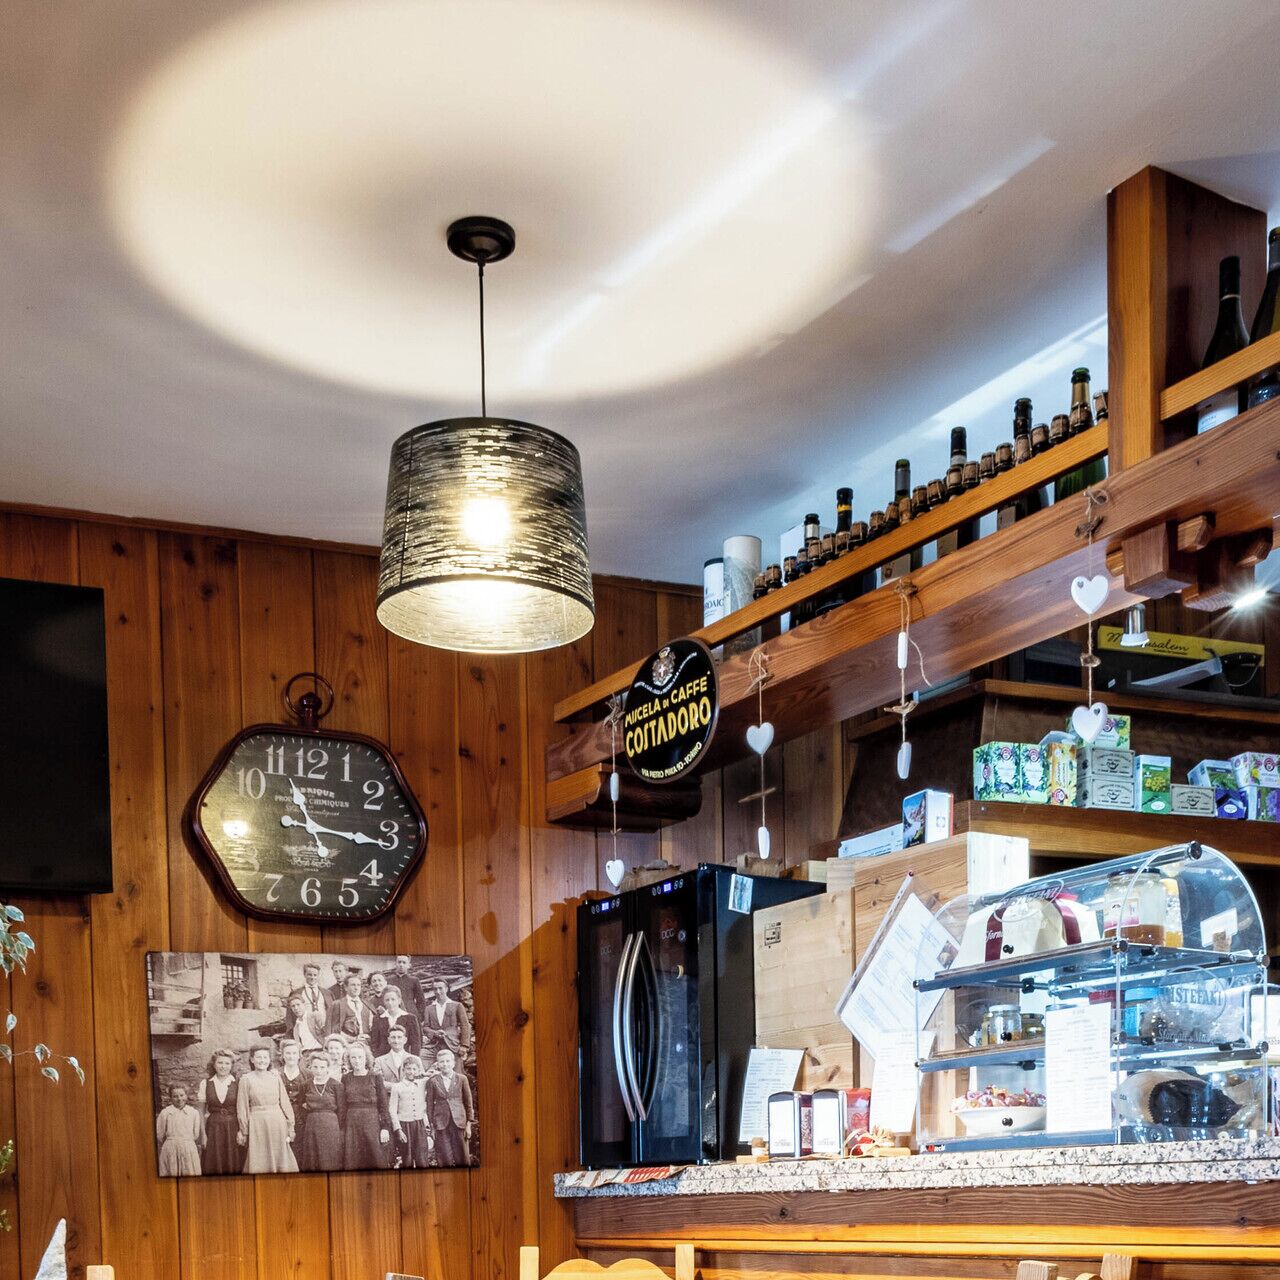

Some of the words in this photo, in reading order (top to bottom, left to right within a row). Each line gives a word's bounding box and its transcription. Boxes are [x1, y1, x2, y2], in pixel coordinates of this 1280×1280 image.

[625, 696, 711, 758] COSTADORO
[264, 744, 287, 776] 11
[295, 747, 329, 780] 12
[340, 752, 353, 783] 1
[238, 767, 266, 800] 10
[362, 779, 385, 811] 2
[379, 820, 399, 850] 3
[263, 873, 284, 902] 7
[360, 859, 384, 887] 4
[300, 877, 321, 907] 6
[338, 878, 359, 908] 5
